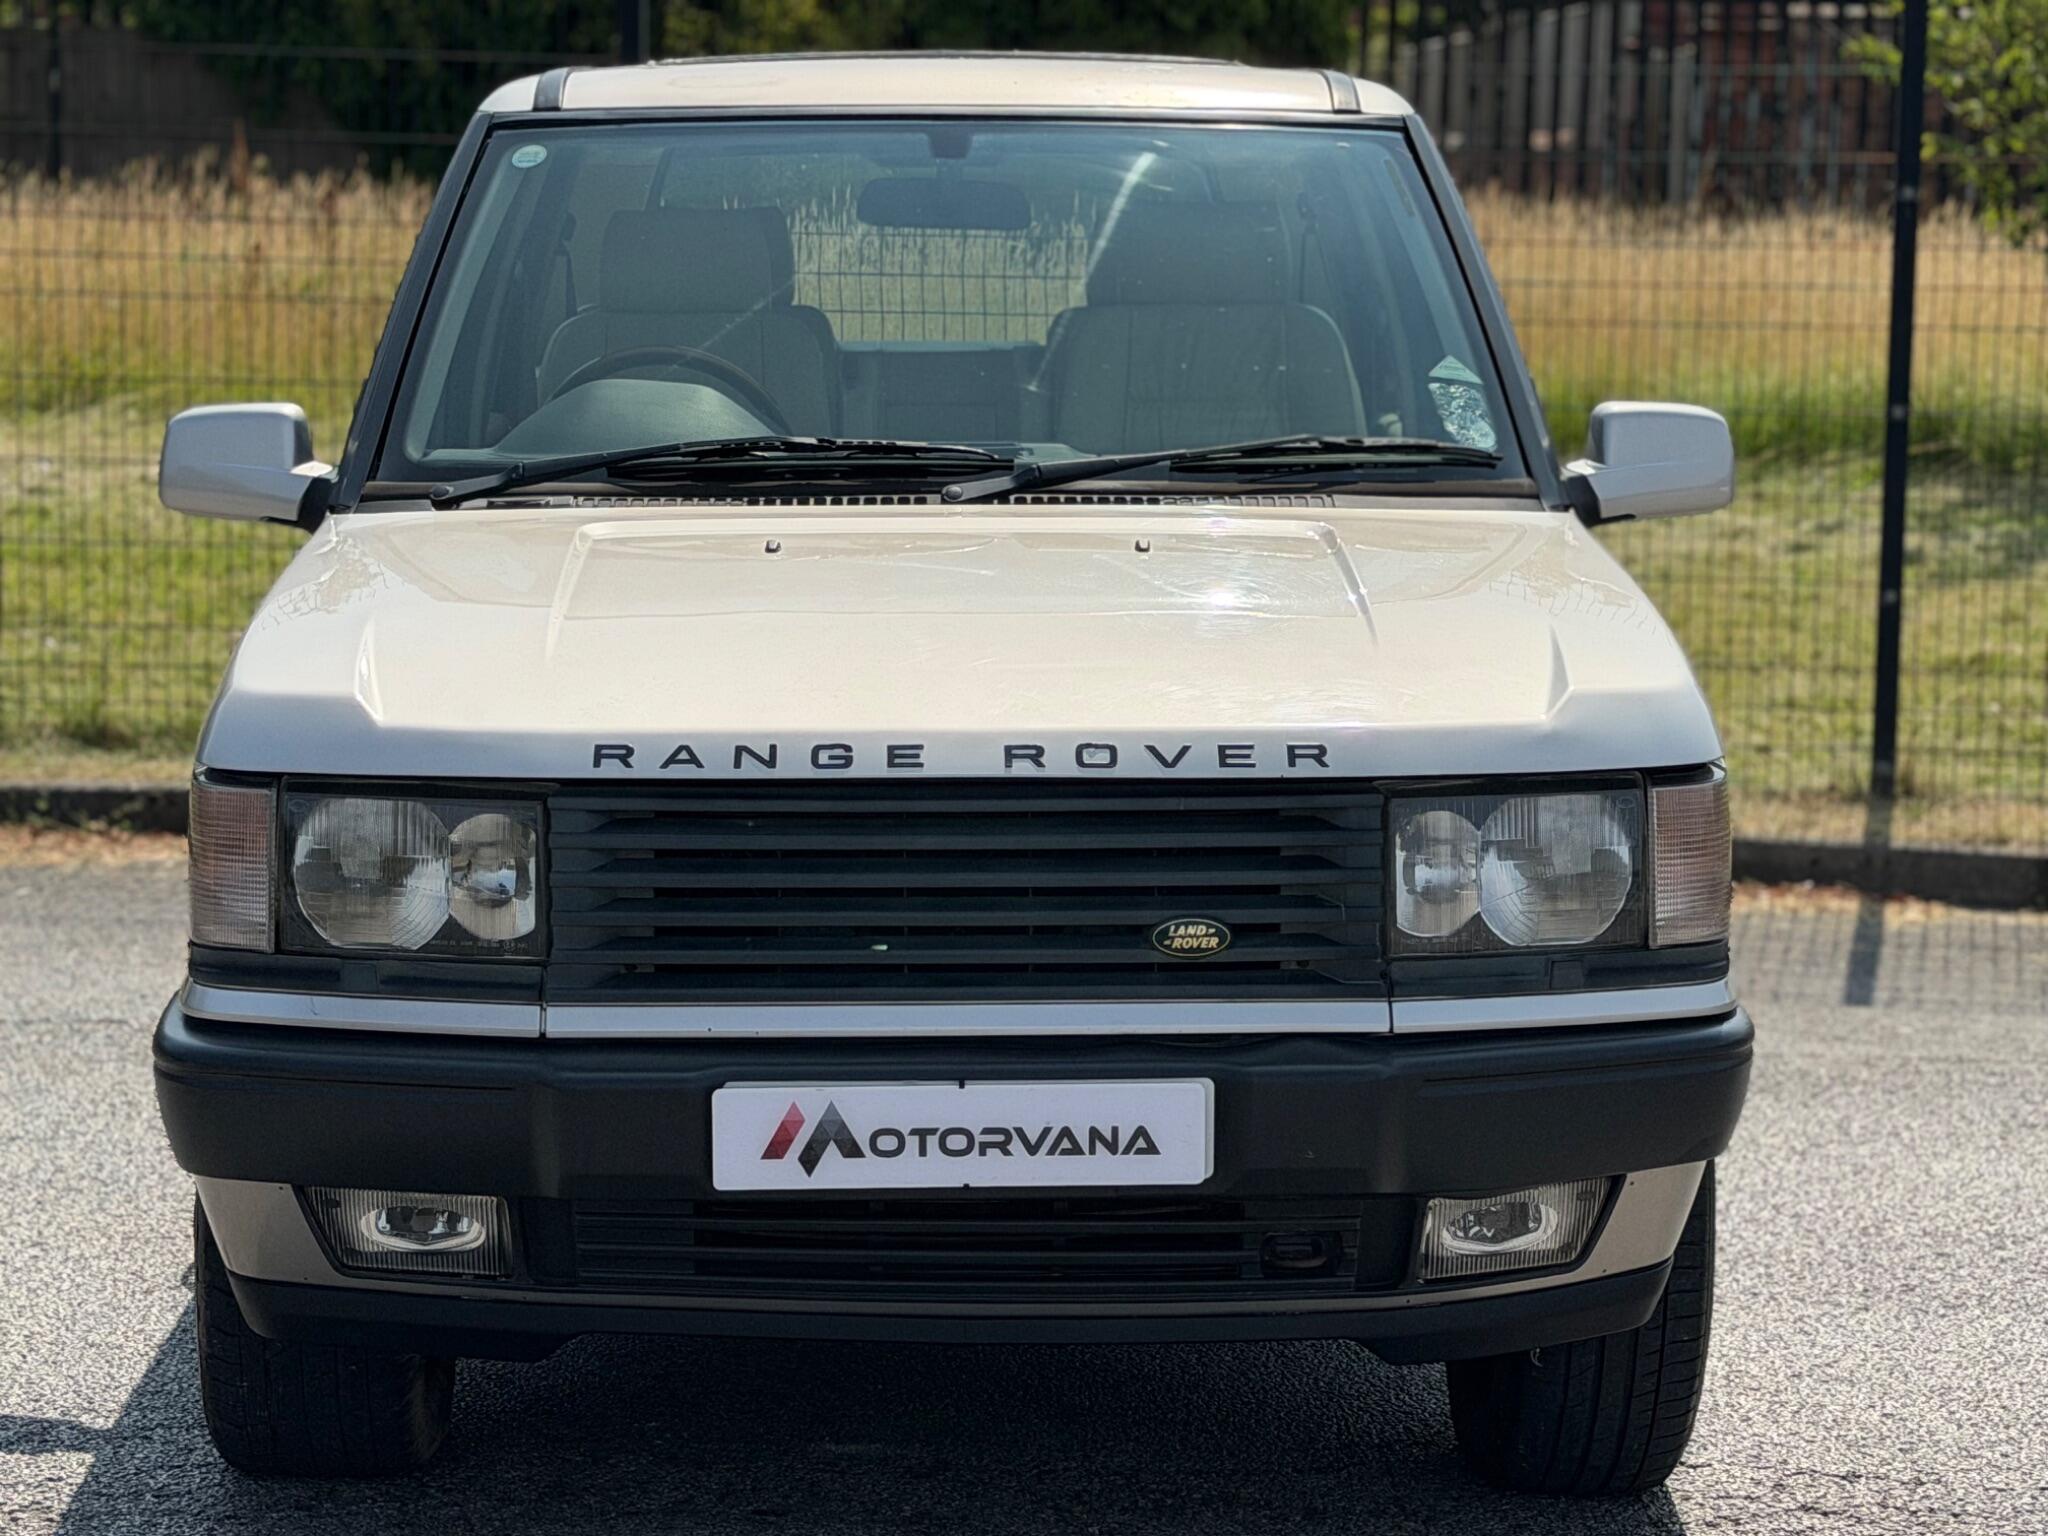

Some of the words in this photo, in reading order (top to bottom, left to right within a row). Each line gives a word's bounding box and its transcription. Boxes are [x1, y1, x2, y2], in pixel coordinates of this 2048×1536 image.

[593, 743, 926, 769] RANGE
[1004, 743, 1330, 769] ROVER
[1168, 924, 1208, 937] LAND
[1171, 937, 1220, 949] ROVER
